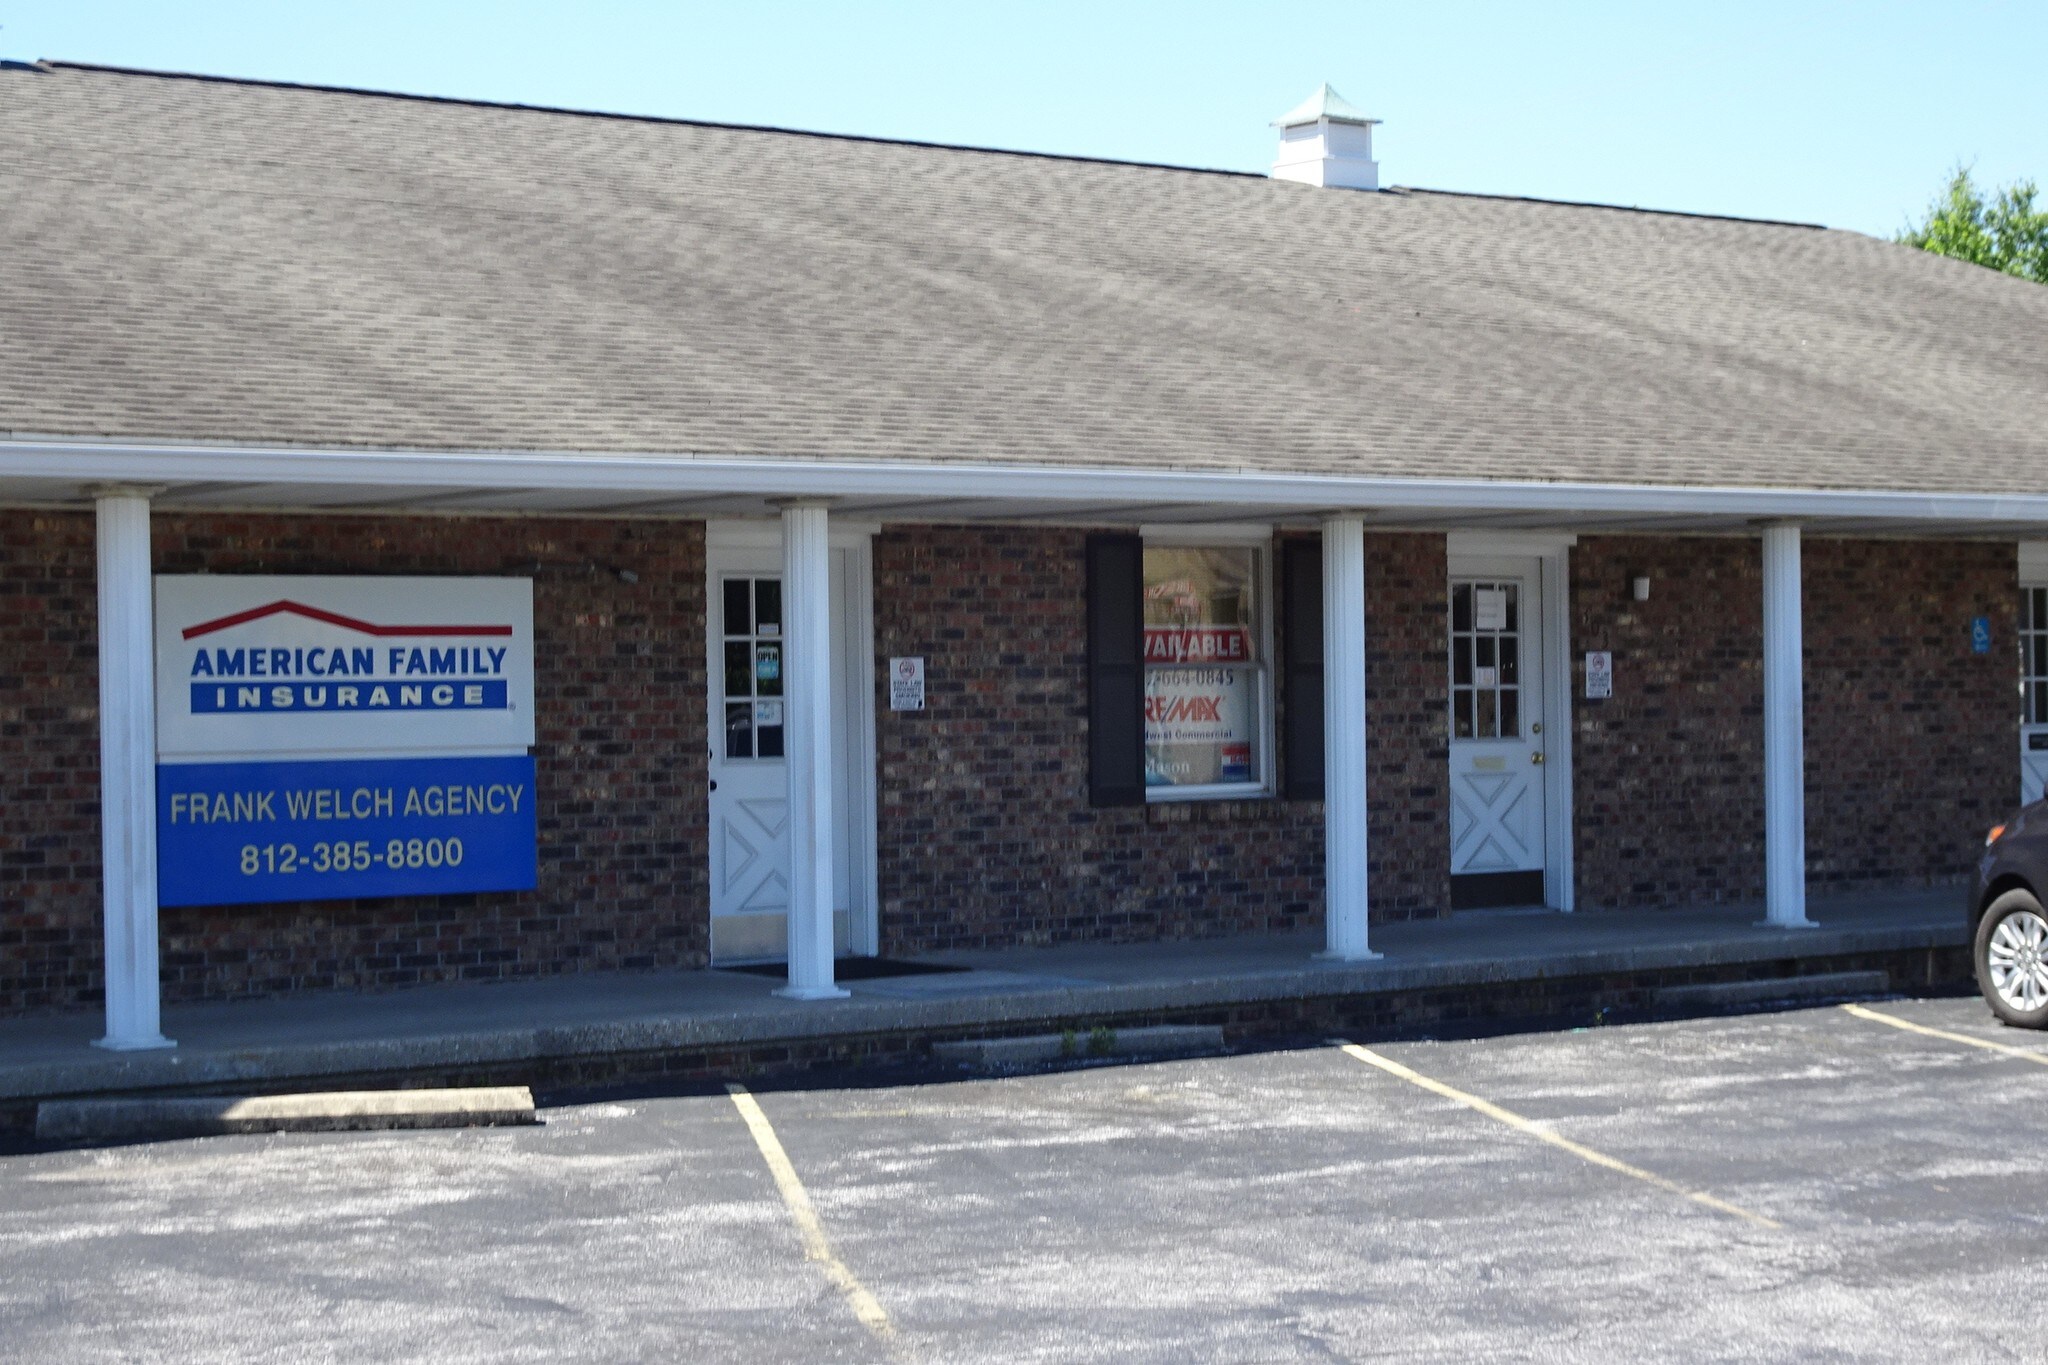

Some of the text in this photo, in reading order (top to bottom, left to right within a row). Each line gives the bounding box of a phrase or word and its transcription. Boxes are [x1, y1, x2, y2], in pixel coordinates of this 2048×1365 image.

[757, 651, 778, 662] OPEN
[1144, 634, 1241, 657] VAILABLE
[190, 646, 507, 678] AMERICAN FAMILY
[216, 684, 484, 708] INSURANCE
[1145, 696, 1222, 723] RE/MAX
[170, 784, 524, 824] FRANK WELCH AGENCY
[240, 837, 464, 876] 812-385-8800
